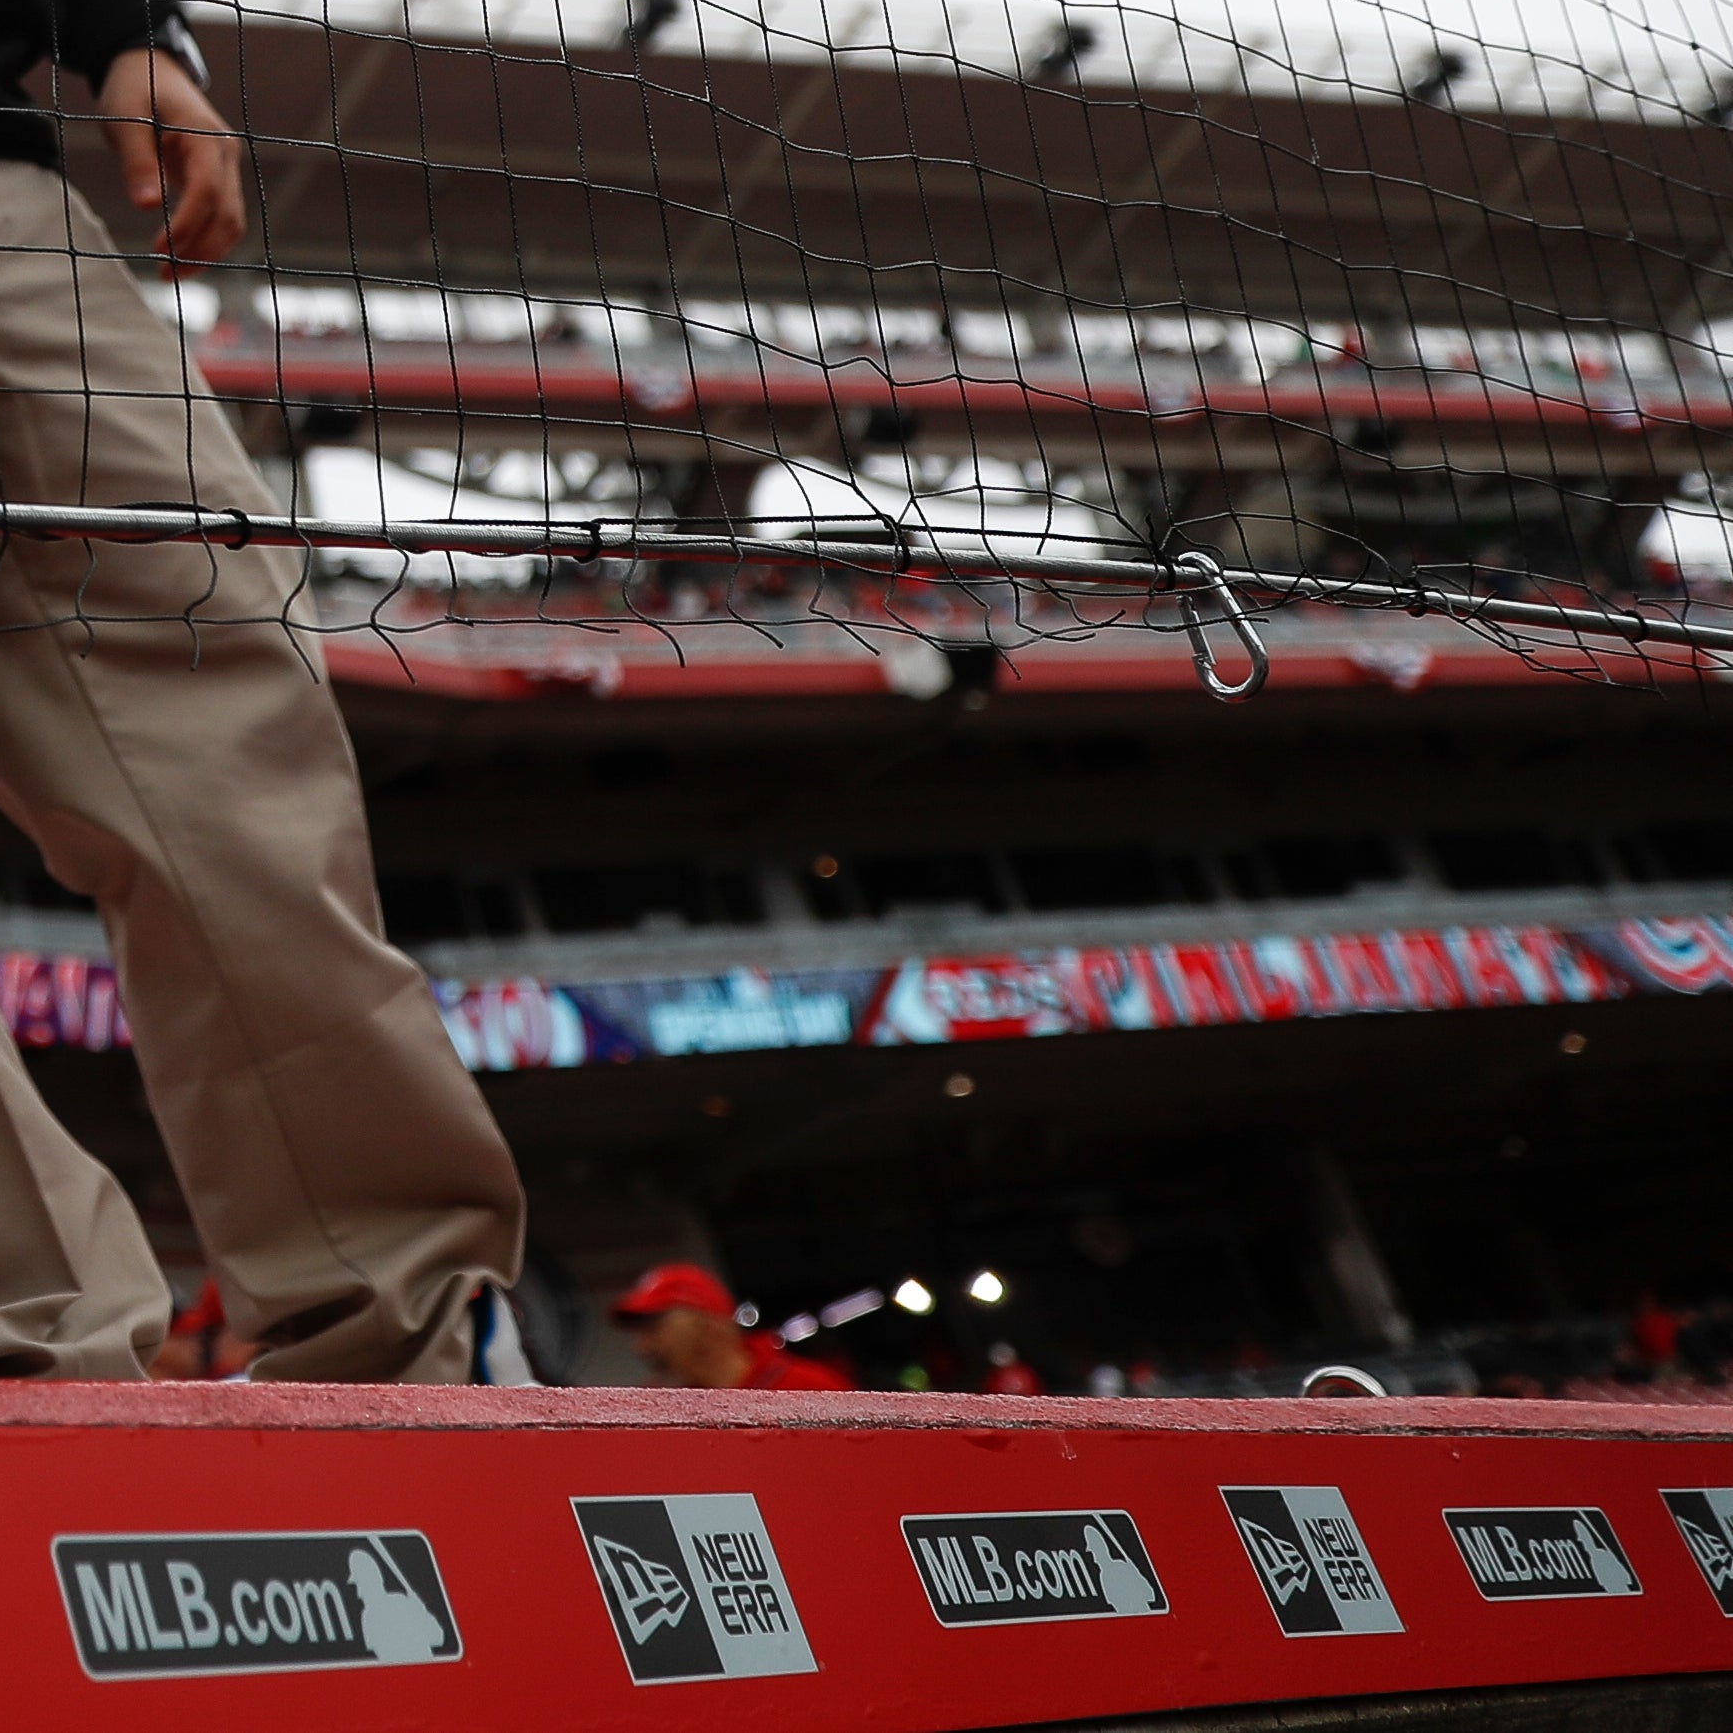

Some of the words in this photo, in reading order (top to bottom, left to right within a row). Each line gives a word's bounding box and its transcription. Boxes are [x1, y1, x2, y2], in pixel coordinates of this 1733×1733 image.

[691, 1532, 768, 1583] NEW
[1303, 1518, 1359, 1558] NEW
[1456, 1525, 1592, 1583] MLB.com
[917, 1535, 1099, 1605] MLB.com
[1323, 1559, 1381, 1601] ERA
[75, 1561, 354, 1653] MLB.com
[712, 1584, 790, 1635] ERA
